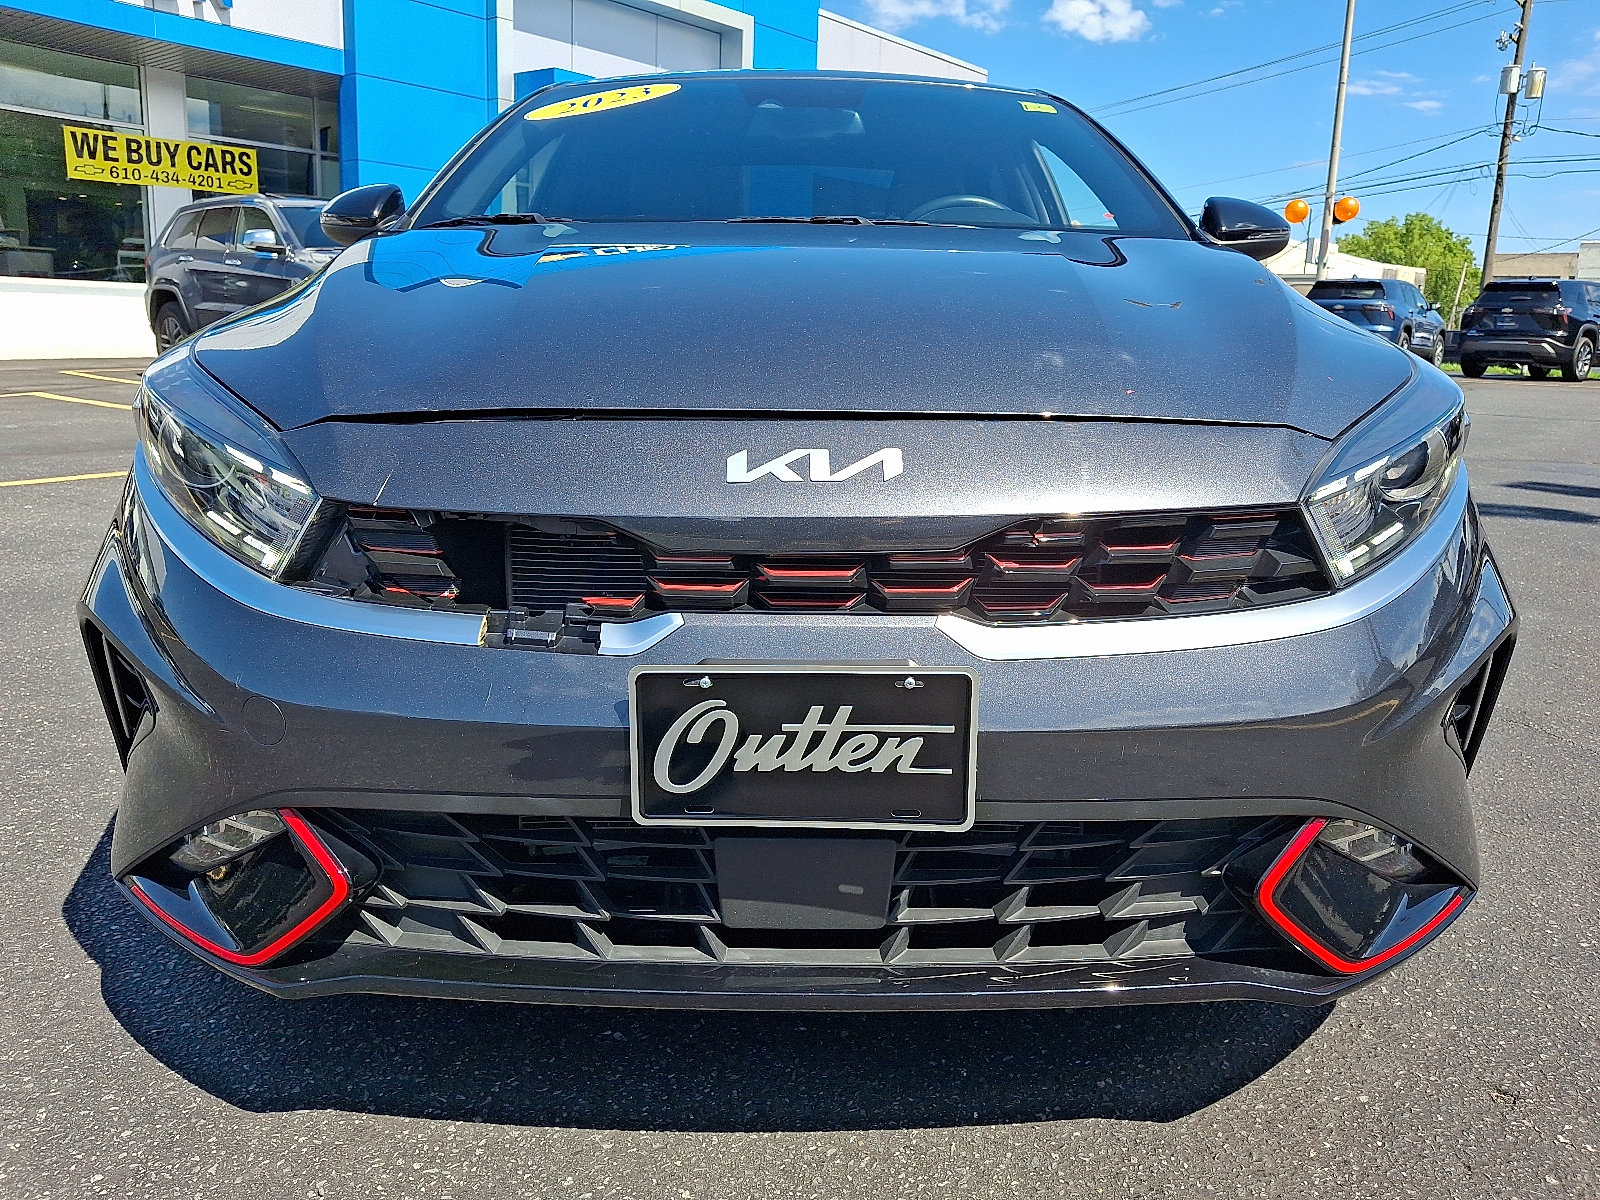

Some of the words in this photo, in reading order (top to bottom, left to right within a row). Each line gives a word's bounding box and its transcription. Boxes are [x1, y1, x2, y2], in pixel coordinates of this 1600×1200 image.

[70, 131, 119, 163] WE
[125, 138, 180, 168] BUY
[186, 145, 253, 176] CARS
[109, 166, 224, 189] 610-434-4201
[726, 448, 904, 483] KIA
[653, 699, 955, 794] Outten
